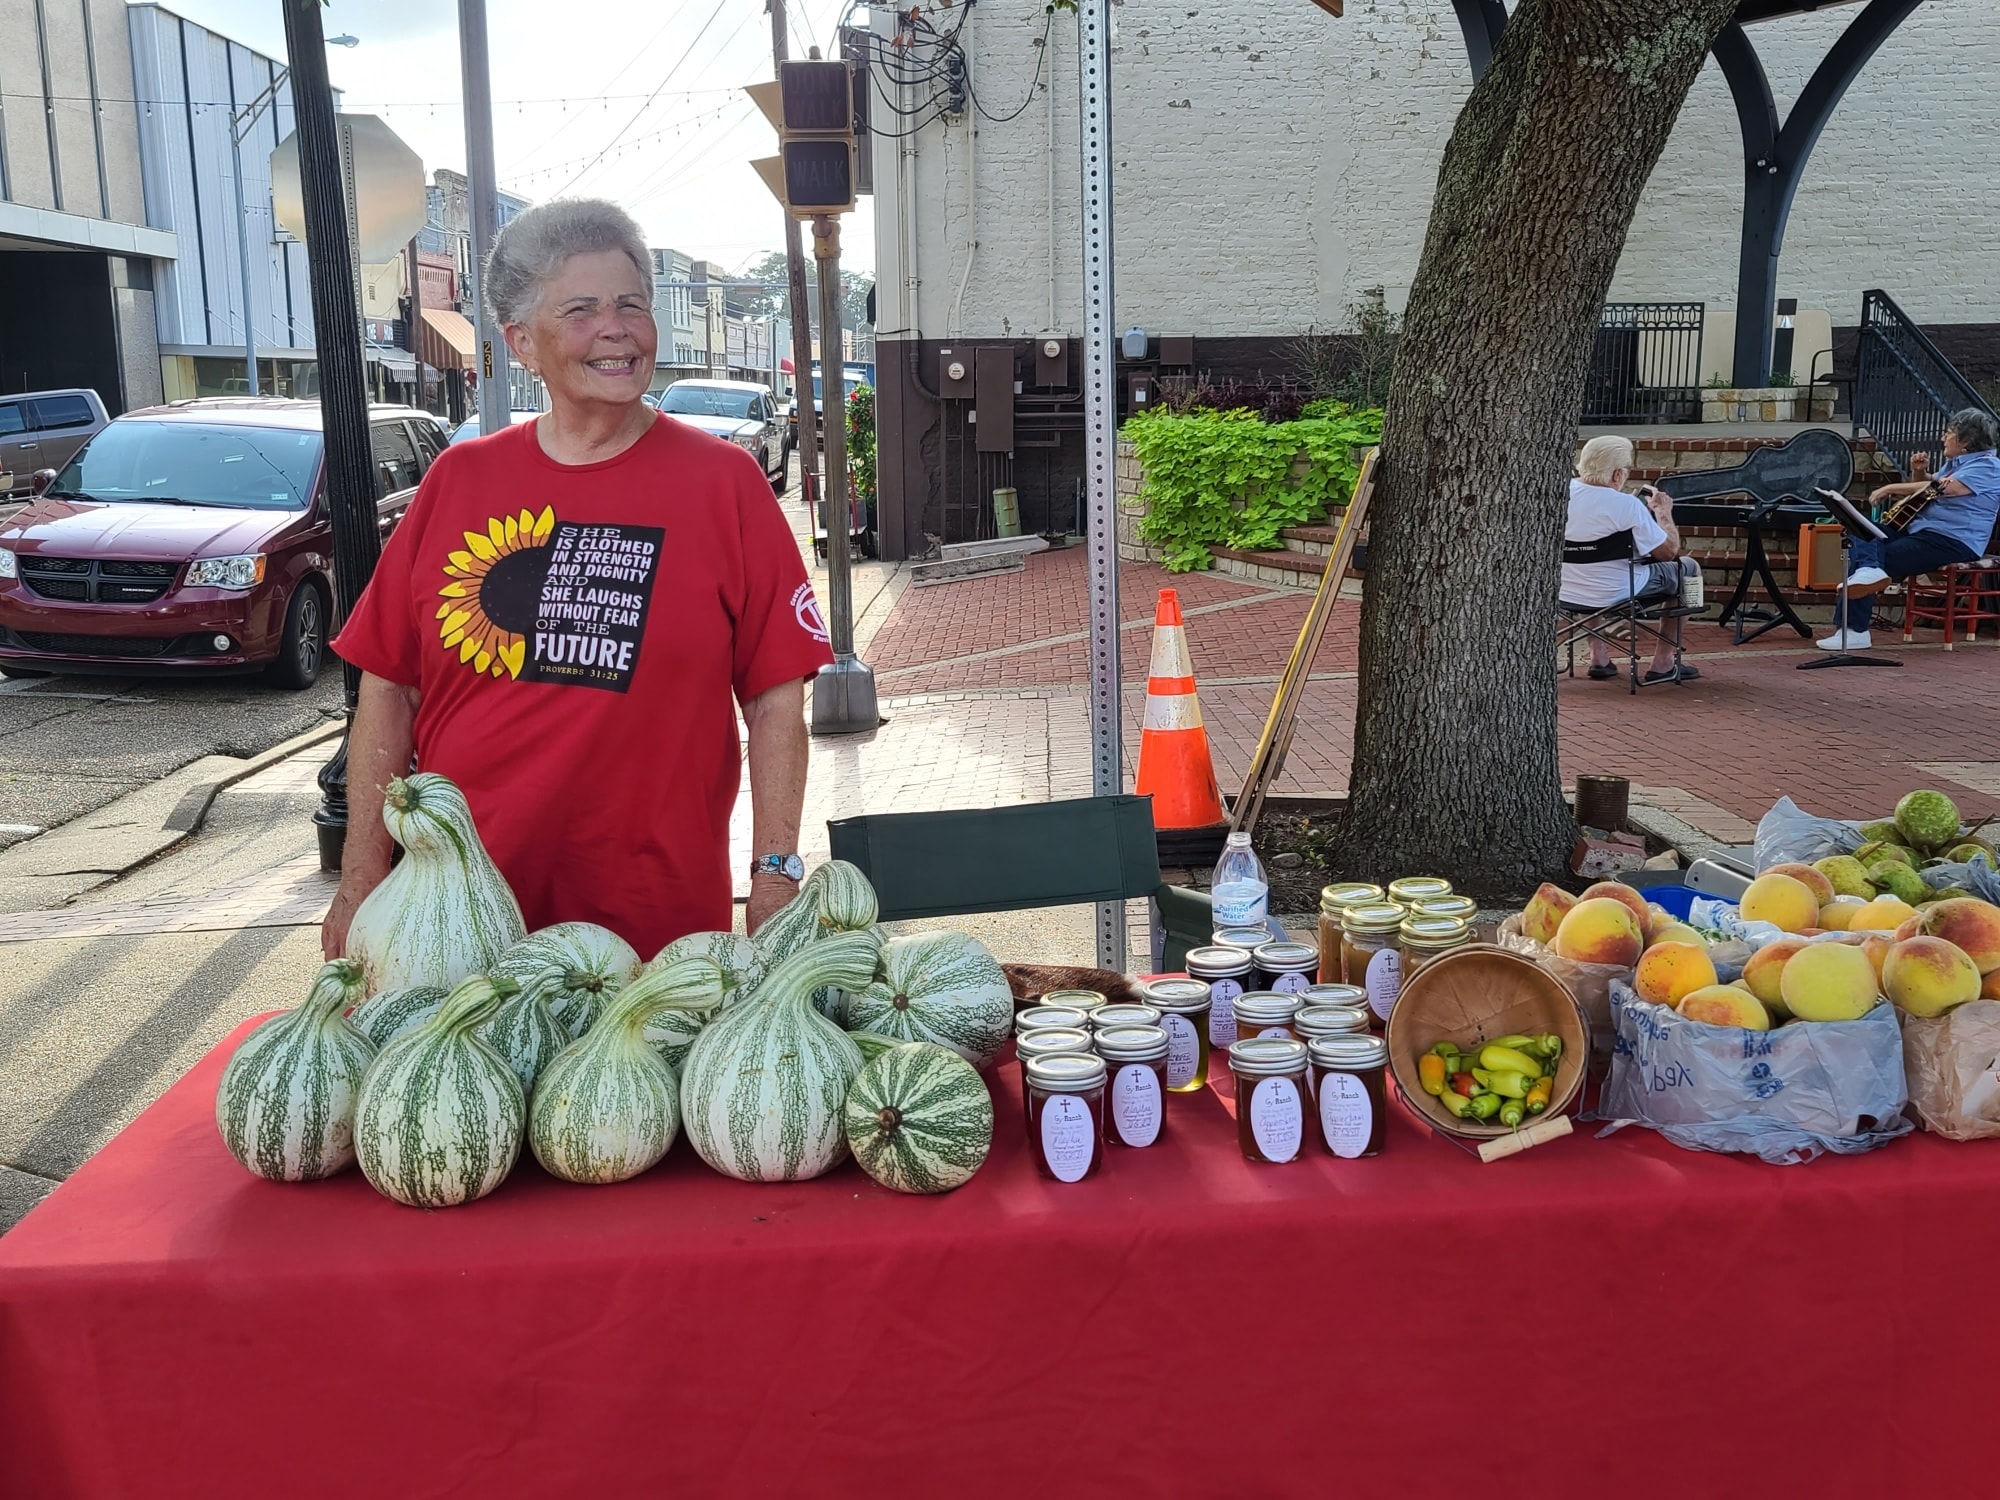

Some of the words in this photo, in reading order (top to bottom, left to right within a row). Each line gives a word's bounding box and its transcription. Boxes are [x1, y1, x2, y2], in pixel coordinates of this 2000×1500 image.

[790, 98, 844, 126] WALK
[792, 159, 845, 188] WALK
[484, 341, 492, 378] 231
[560, 526, 621, 538] SHE
[555, 537, 574, 550] IS
[578, 538, 655, 555] CLOTHED
[551, 550, 569, 563] IN
[572, 551, 652, 570] STRENGTH
[544, 576, 589, 586] AND
[547, 563, 581, 576] AND
[584, 564, 648, 584] DIGNITY
[540, 586, 573, 601] SHE
[576, 587, 643, 610] LAUGHS
[538, 603, 601, 621] WITHOUT
[603, 607, 640, 628] FEAR
[535, 619, 560, 630] OF
[573, 621, 610, 635] THE
[534, 632, 634, 671] FUTURE
[539, 665, 584, 676] PROVERBS
[590, 669, 619, 680] 31:25
[1218, 904, 1249, 913] Purified
[1221, 911, 1245, 920] Water
[1275, 1096, 1292, 1105] Ranch
[1064, 1113, 1083, 1122] Ranch
